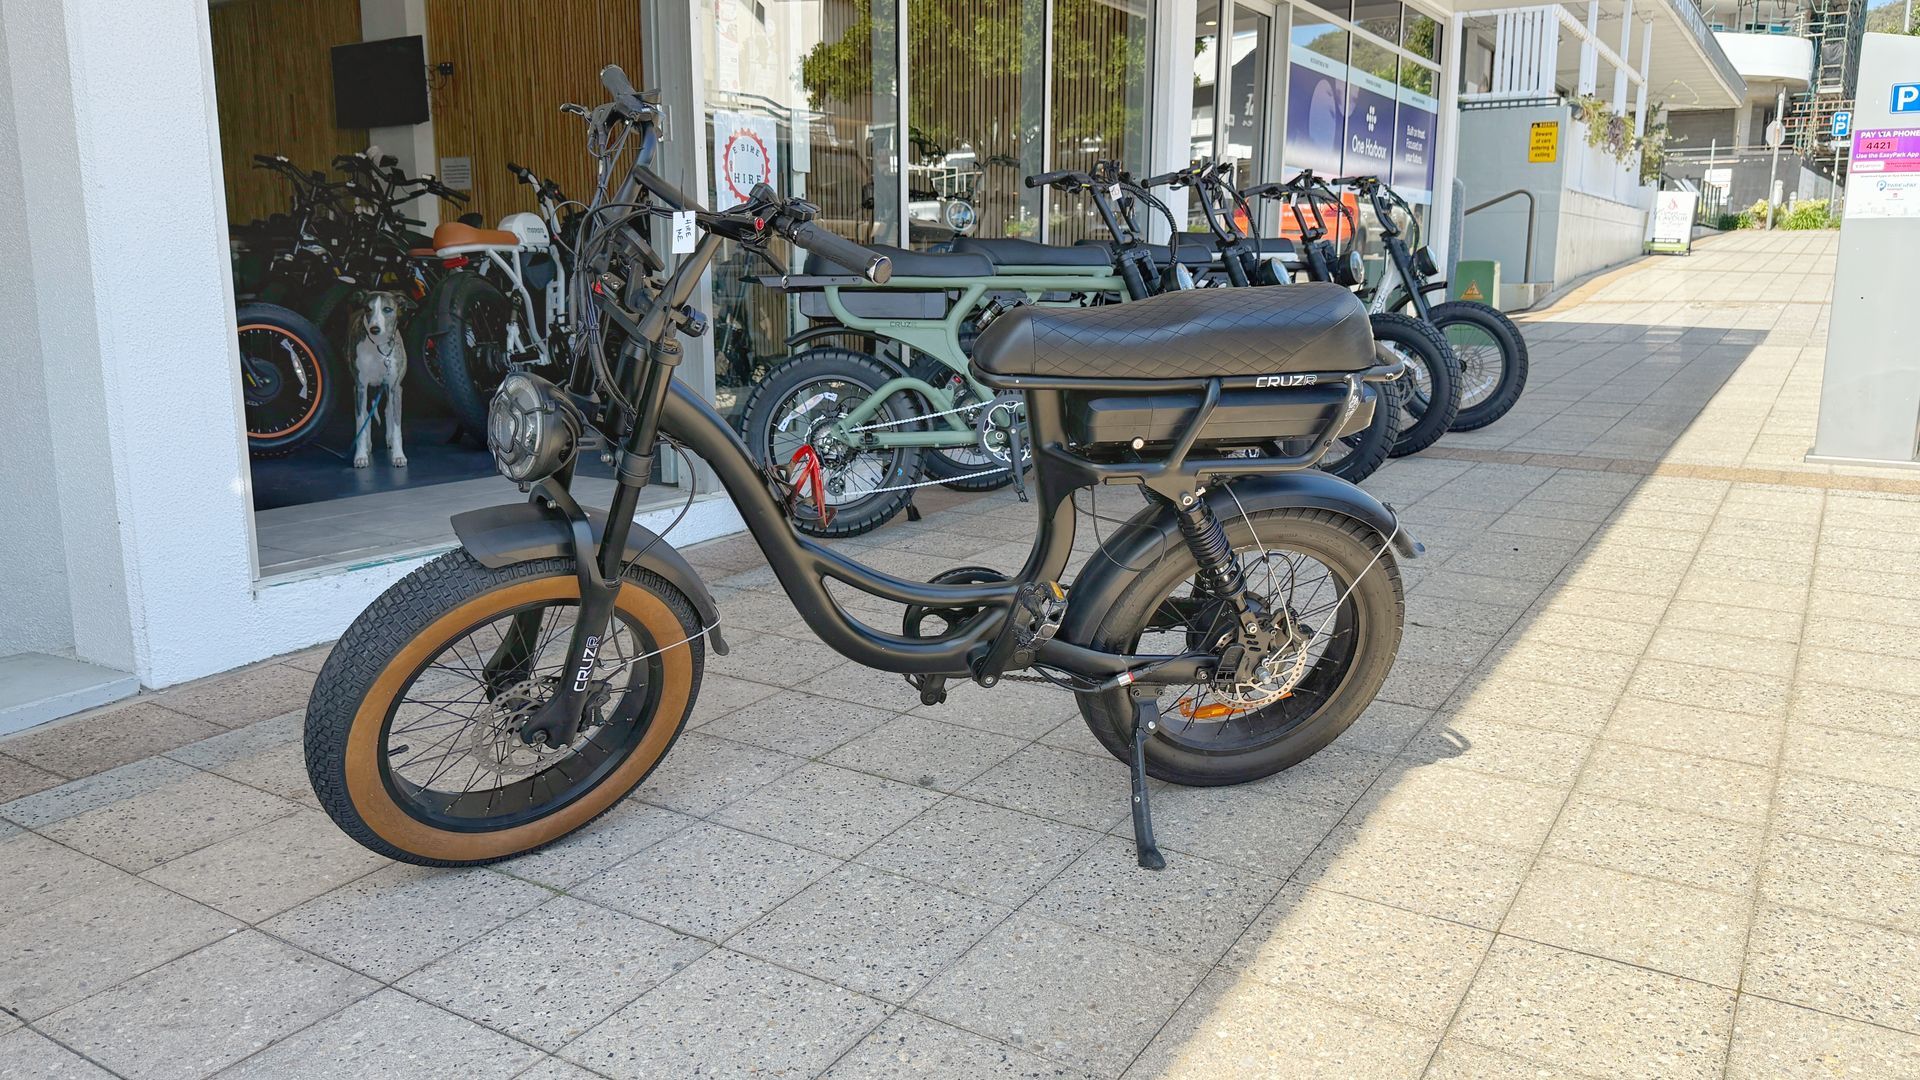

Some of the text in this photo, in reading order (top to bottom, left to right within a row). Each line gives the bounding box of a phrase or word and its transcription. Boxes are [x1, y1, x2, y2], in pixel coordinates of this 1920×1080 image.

[1897, 86, 1919, 111] P
[1835, 122, 1846, 134] P
[732, 144, 760, 157] E BIKE
[1352, 135, 1387, 159] One Harbour
[1866, 141, 1891, 150] 4421
[734, 173, 762, 185] HIRE
